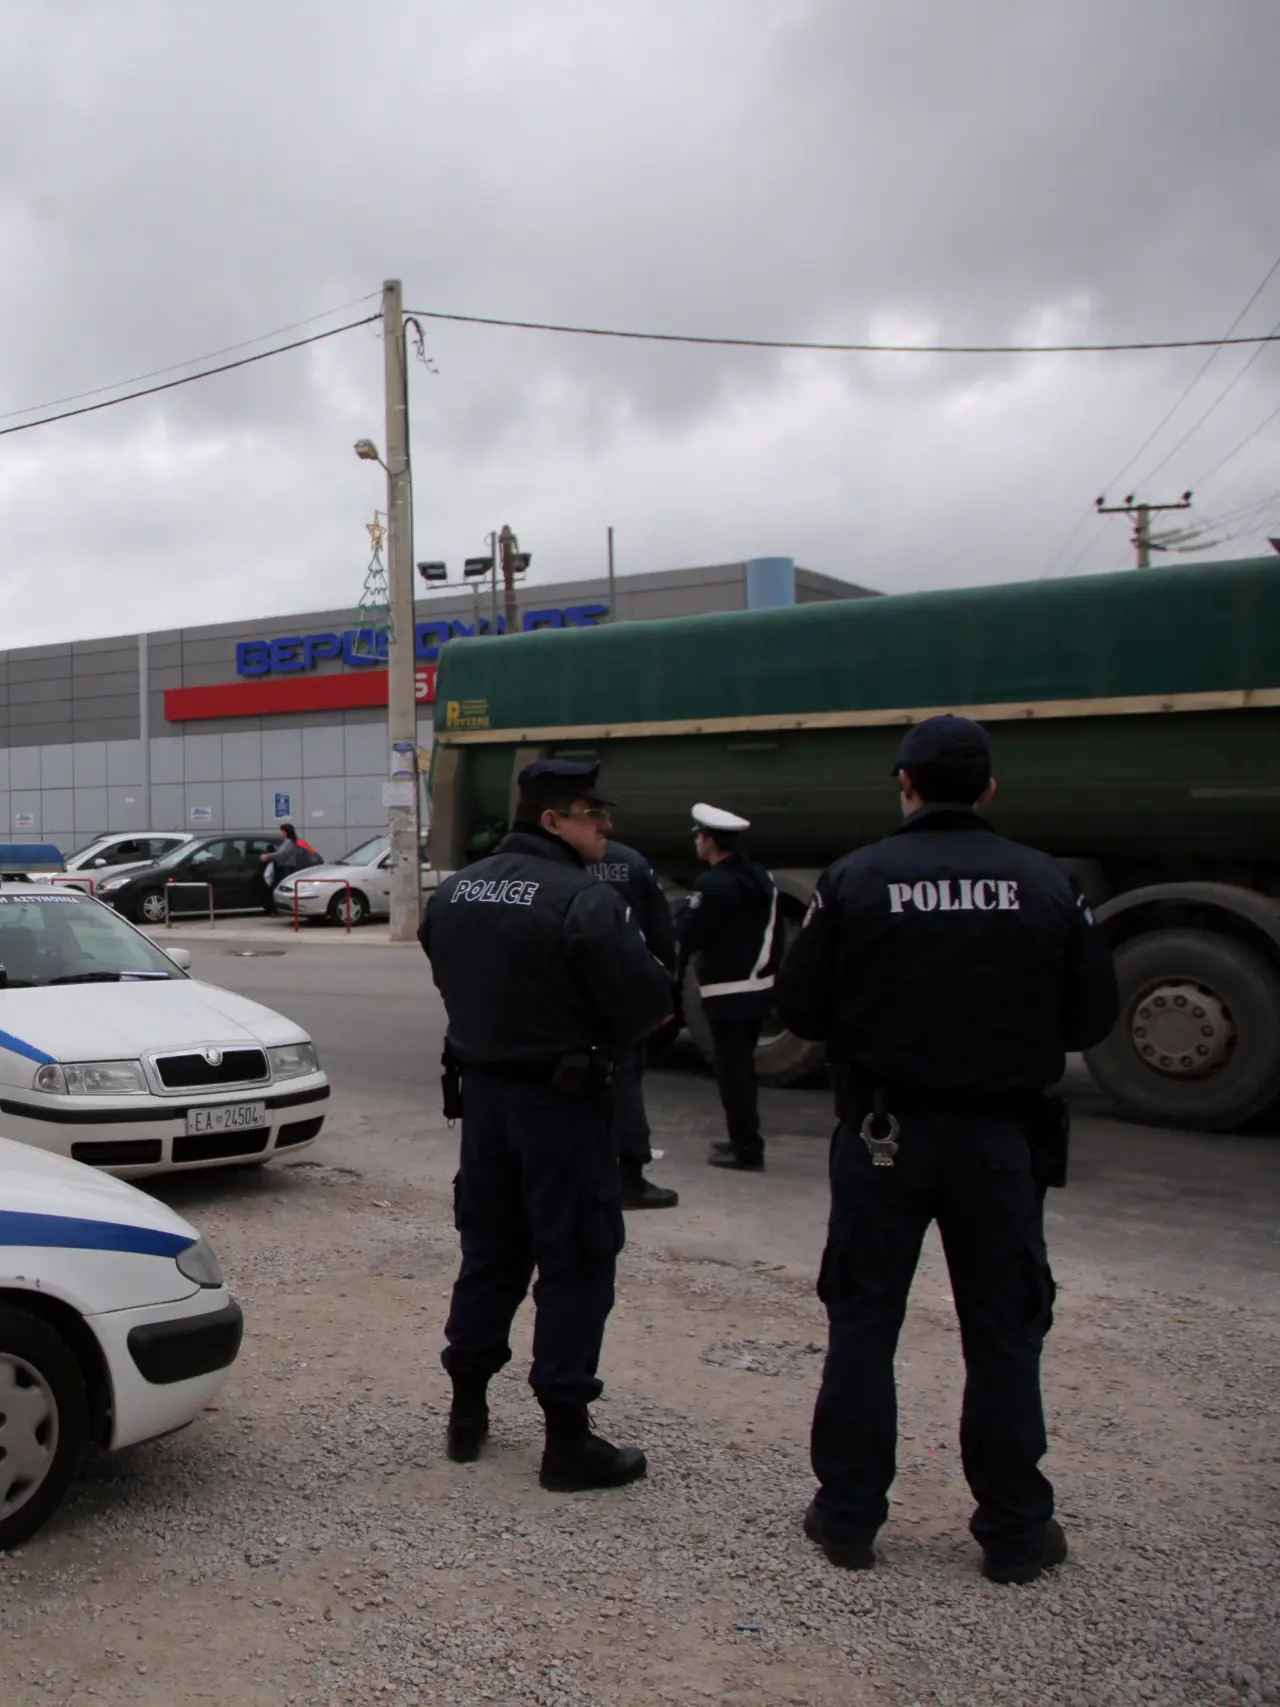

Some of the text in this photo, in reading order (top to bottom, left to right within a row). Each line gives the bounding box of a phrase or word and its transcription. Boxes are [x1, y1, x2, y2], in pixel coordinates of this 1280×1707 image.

[451, 879, 539, 905] POLICE
[887, 879, 1020, 913] POLICE
[224, 1106, 258, 1128] 24504
